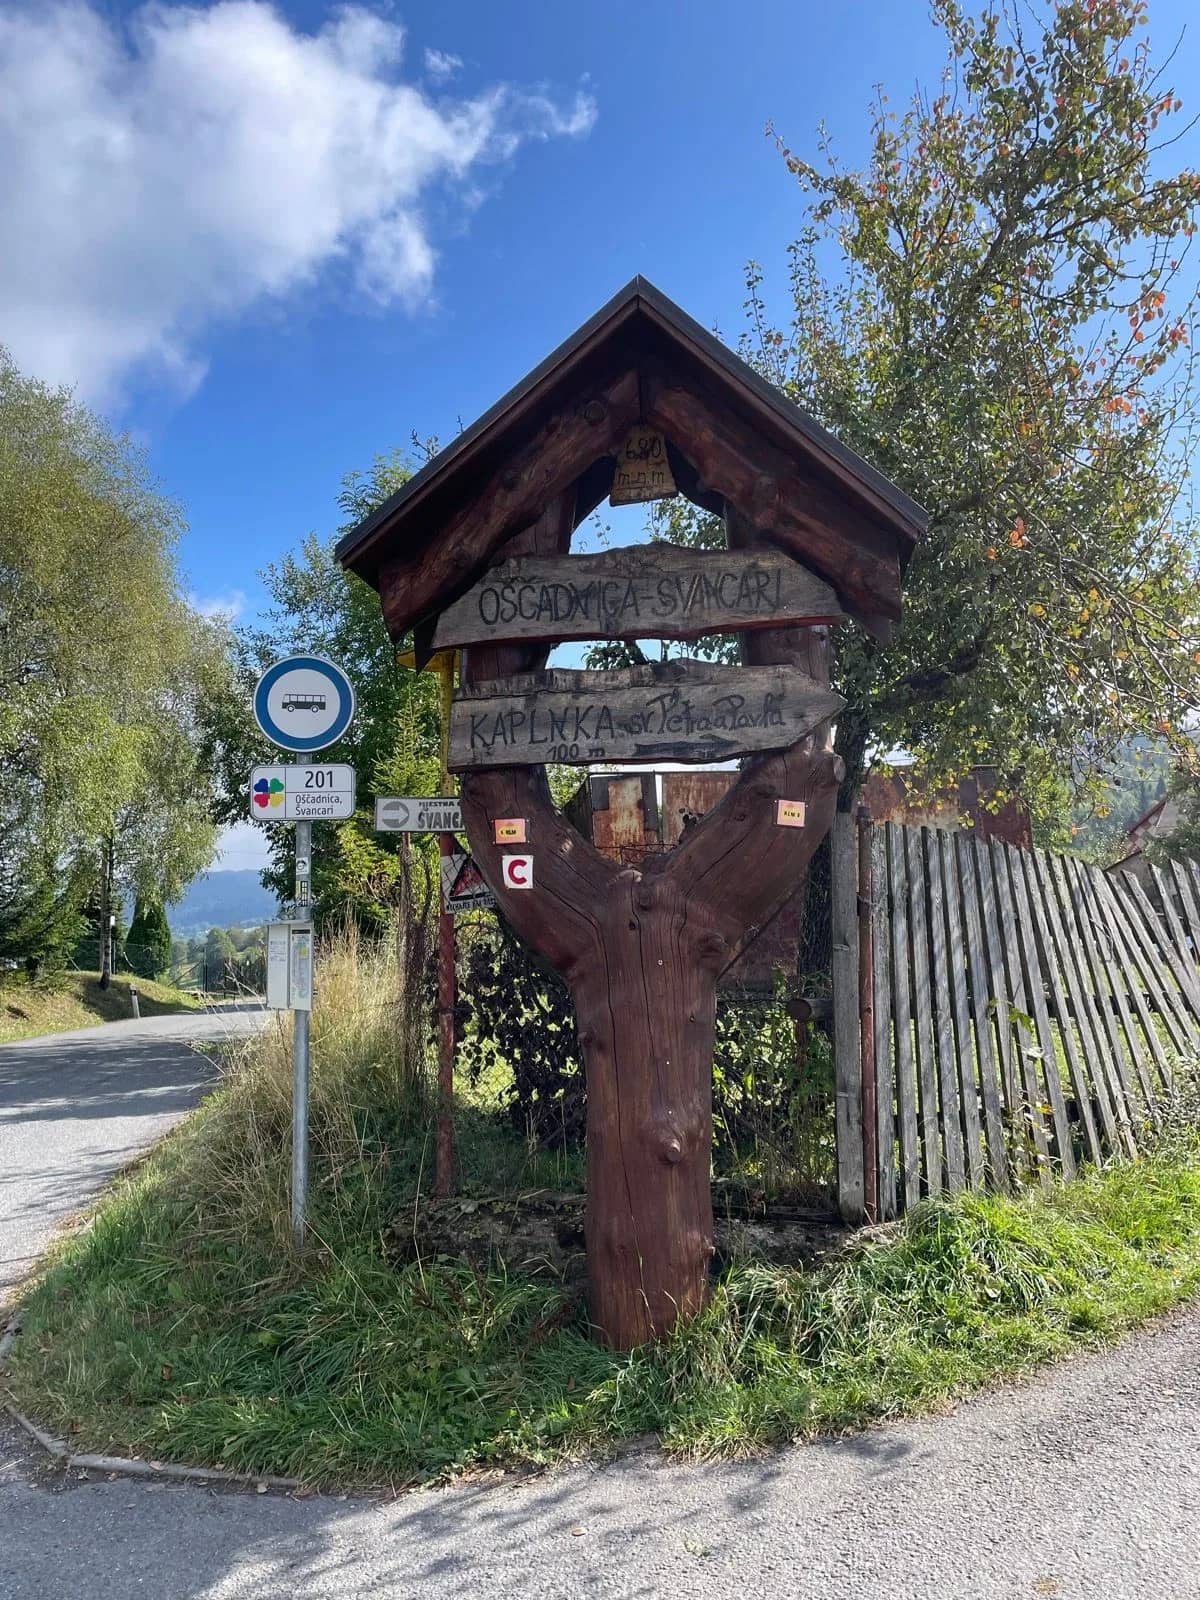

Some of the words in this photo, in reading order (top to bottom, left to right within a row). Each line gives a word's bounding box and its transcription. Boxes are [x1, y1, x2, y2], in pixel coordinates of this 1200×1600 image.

[470, 704, 616, 748] KAPLNKA
[546, 743, 580, 761] 100
[587, 747, 606, 758] m
[304, 770, 334, 788] 201
[295, 794, 343, 805] Oščadnica,
[295, 805, 334, 816] Švancari
[508, 859, 527, 885] C
